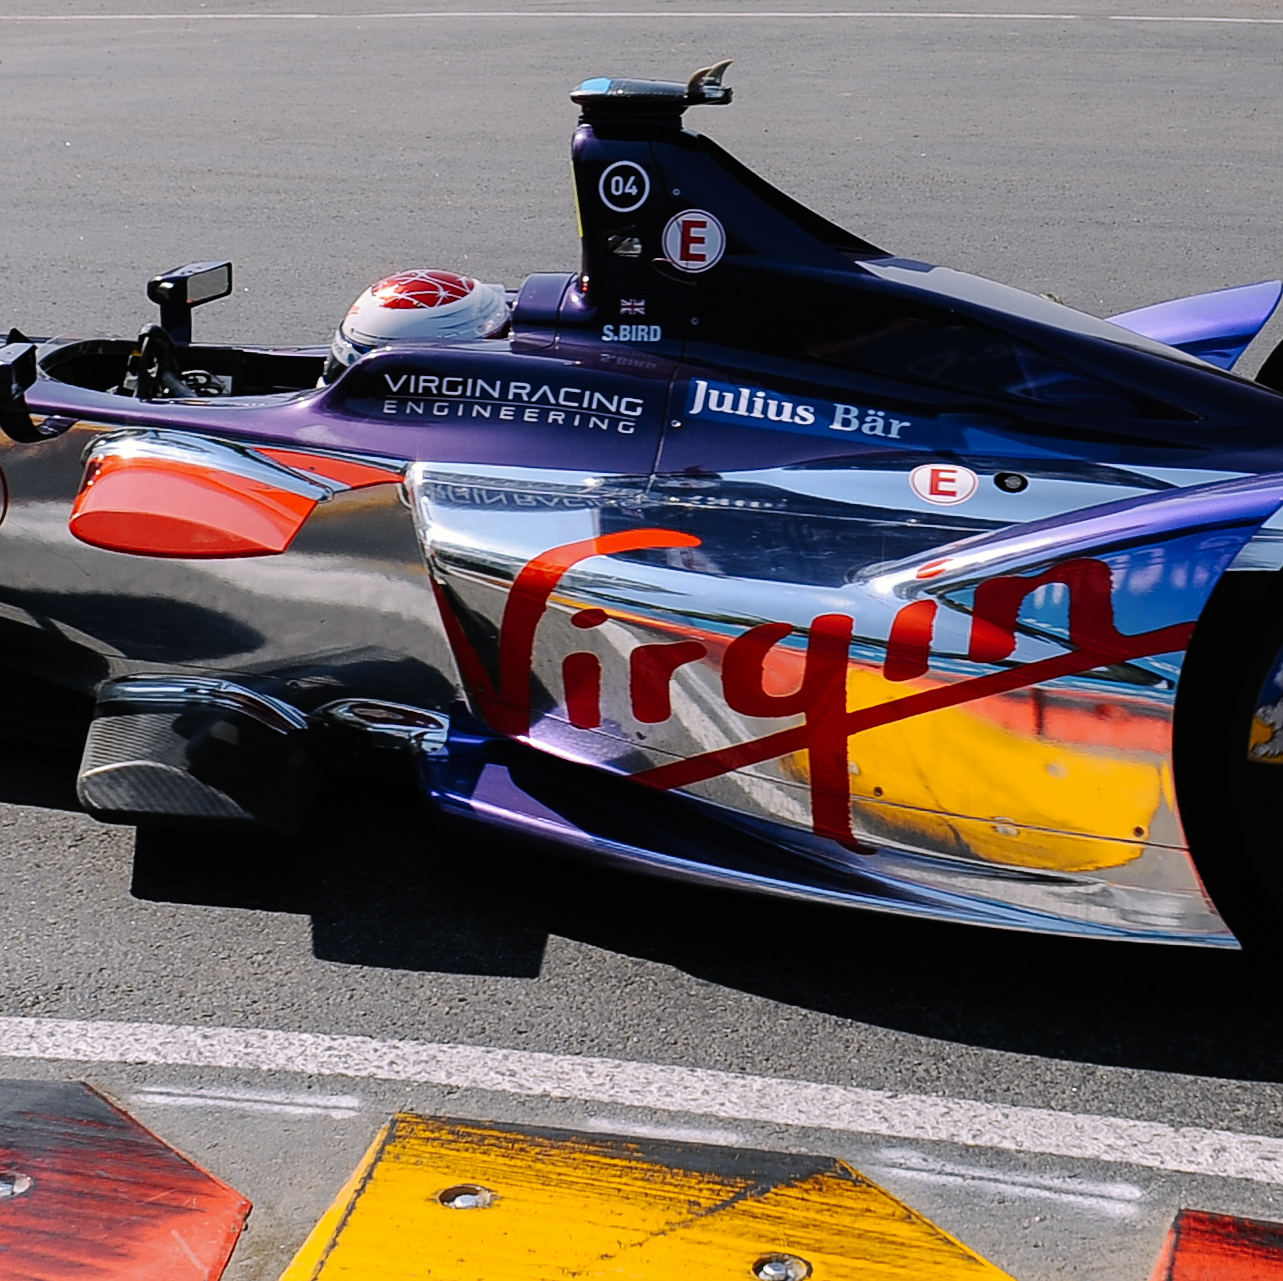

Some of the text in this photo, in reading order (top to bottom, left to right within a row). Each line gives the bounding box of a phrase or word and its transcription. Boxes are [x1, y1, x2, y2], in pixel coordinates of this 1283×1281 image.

[610, 175, 639, 196] 04
[679, 219, 708, 262] E
[601, 324, 662, 342] S.BIRD
[384, 373, 644, 417] VIRGIN RACING
[689, 380, 911, 439] Julius Bär
[383, 399, 635, 434] ENGINEERING
[928, 468, 958, 497] E
[431, 528, 1196, 856] Virgin
